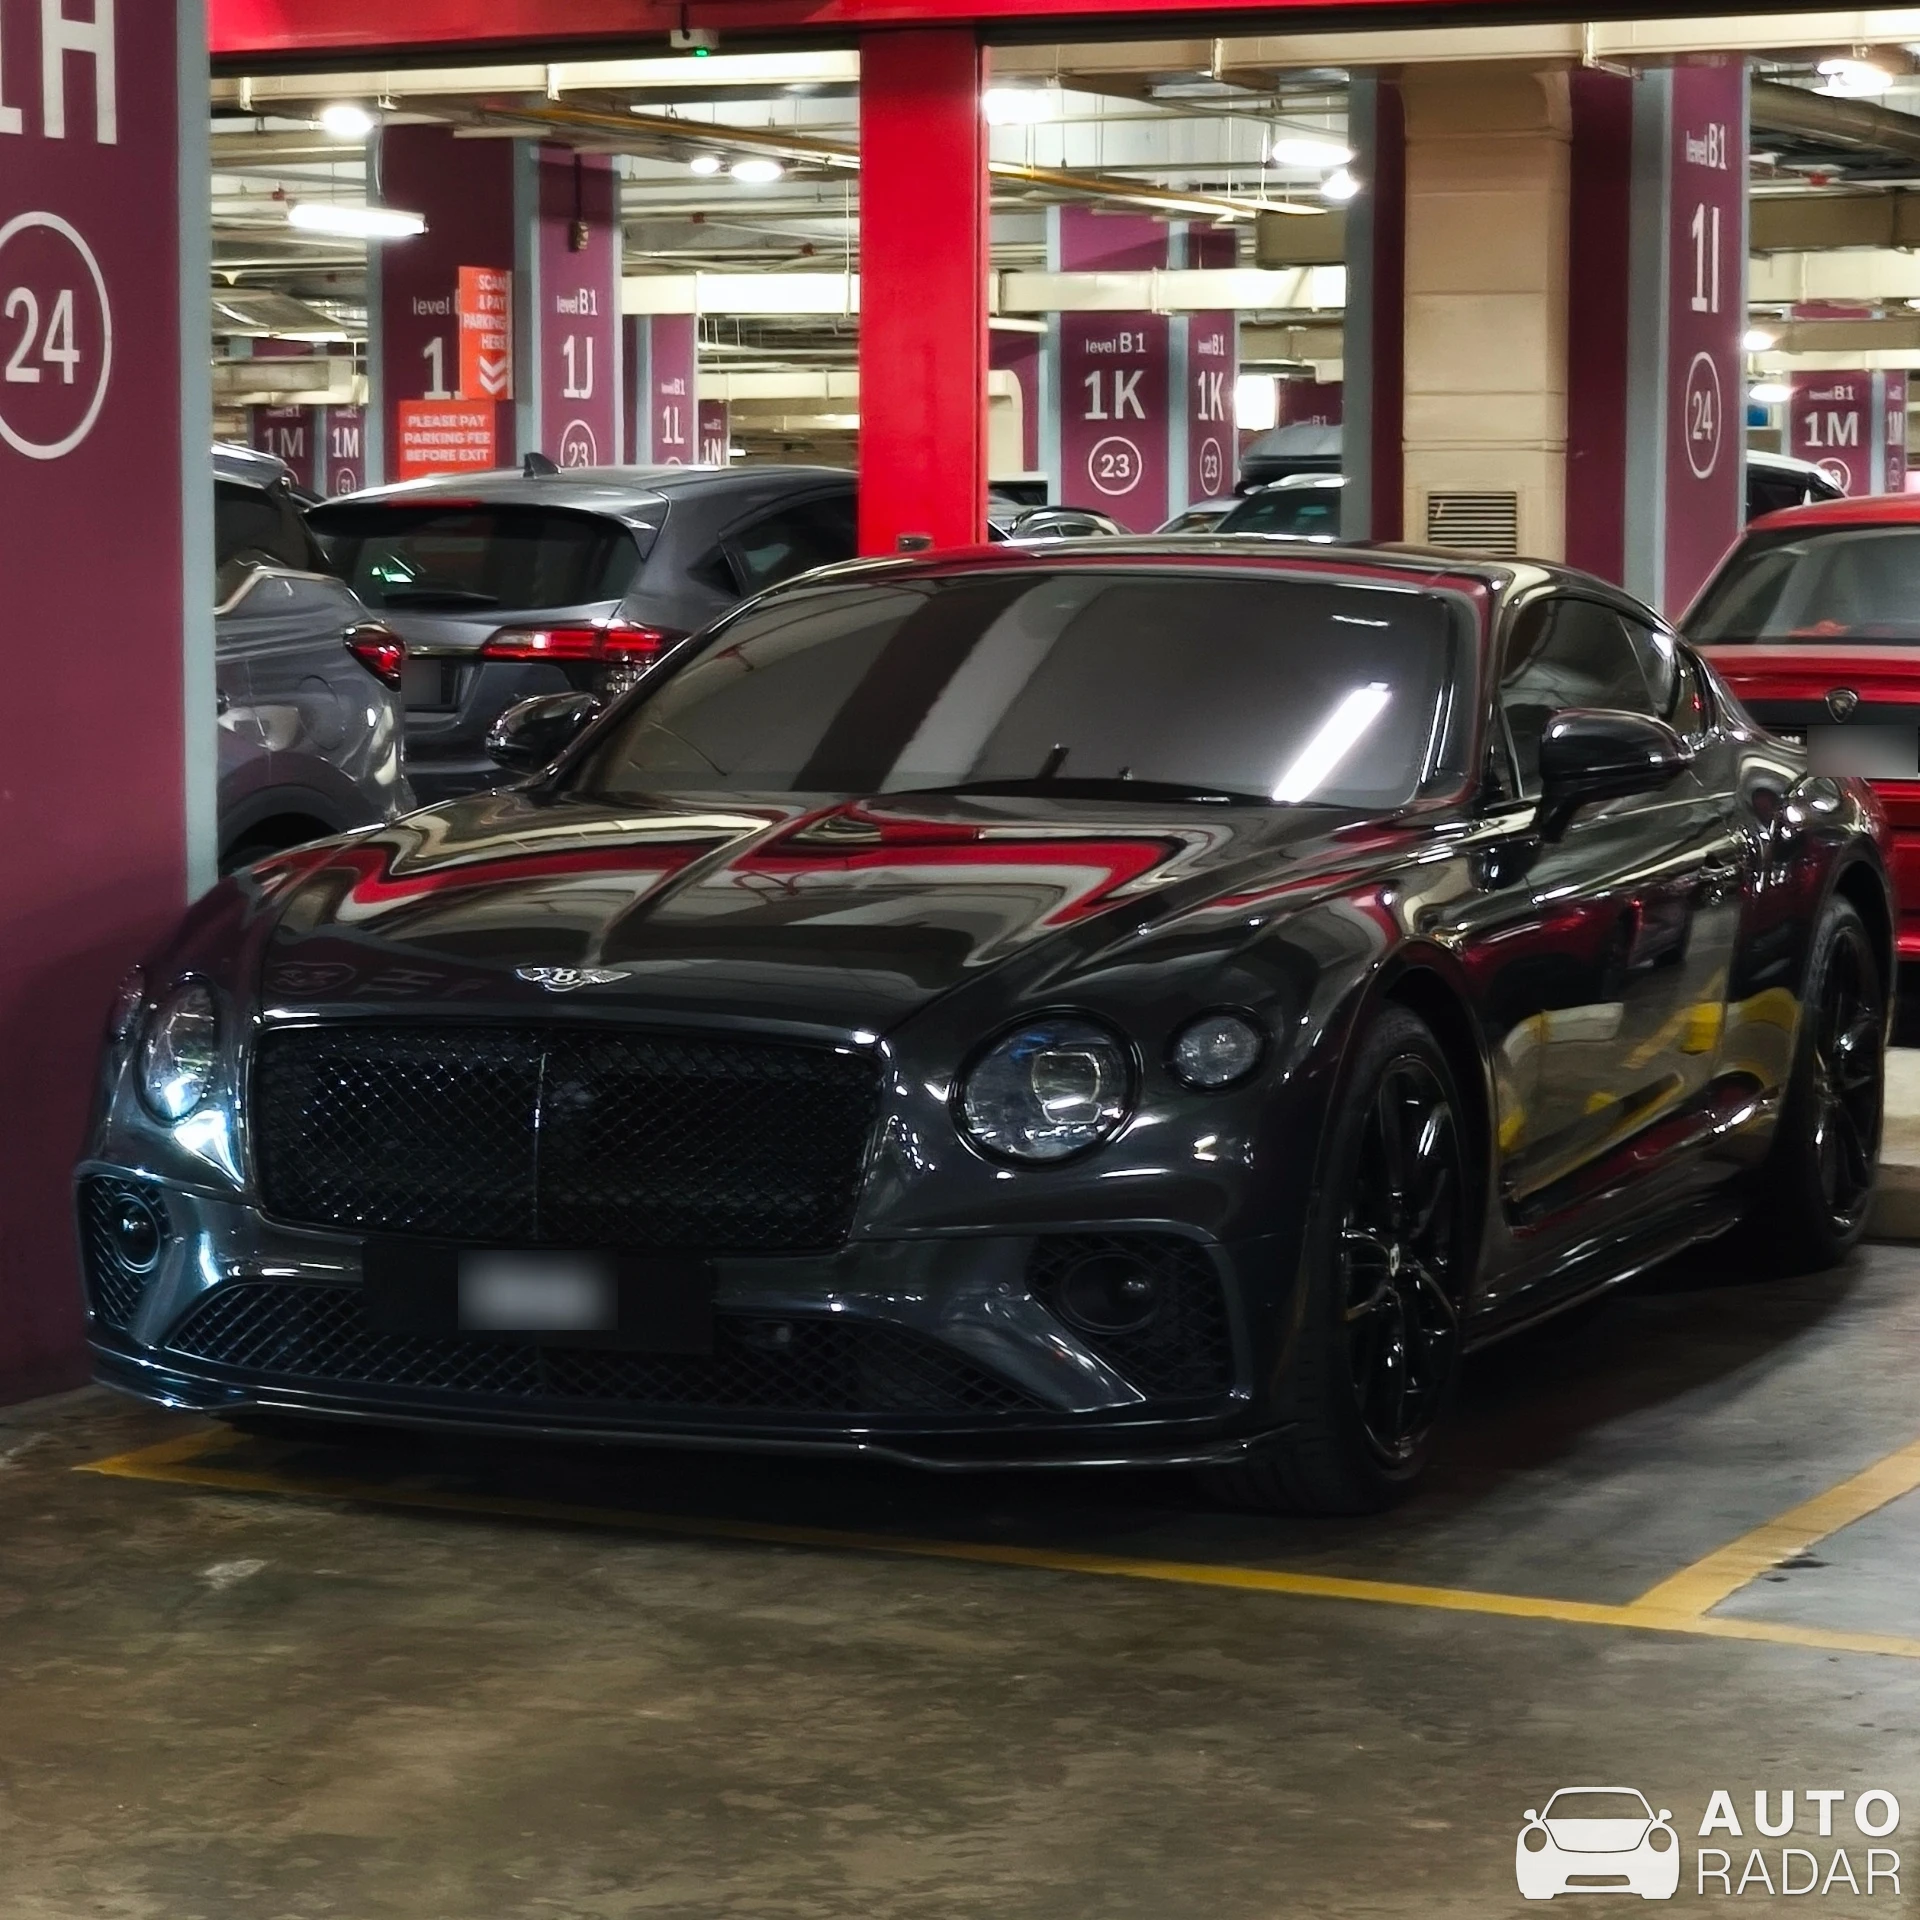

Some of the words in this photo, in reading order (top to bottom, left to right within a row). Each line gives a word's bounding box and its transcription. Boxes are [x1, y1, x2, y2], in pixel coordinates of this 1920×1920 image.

[1708, 123, 1727, 170] B1
[412, 297, 450, 315] level
[579, 288, 598, 316] B1
[5, 286, 80, 384] 24
[1085, 339, 1116, 354] level
[1120, 332, 1146, 353] B1
[563, 335, 593, 399] 1J
[1085, 370, 1146, 420] 1K
[1198, 371, 1224, 421] 1K
[1834, 385, 1855, 400] B1
[408, 415, 457, 427] PLEASE
[460, 414, 486, 427] PAY
[662, 405, 685, 445] 1L
[1693, 390, 1712, 441] 24
[1805, 411, 1859, 446] 1M
[264, 427, 304, 458] 1M
[332, 427, 360, 458] 1M
[404, 432, 464, 445] PARKING
[467, 431, 491, 444] FEE
[703, 438, 722, 465] 1N
[405, 449, 457, 462] BEFORE
[459, 449, 489, 462] EXIT
[569, 441, 589, 467] 23
[1101, 454, 1130, 477] 23
[1204, 455, 1217, 478] 23
